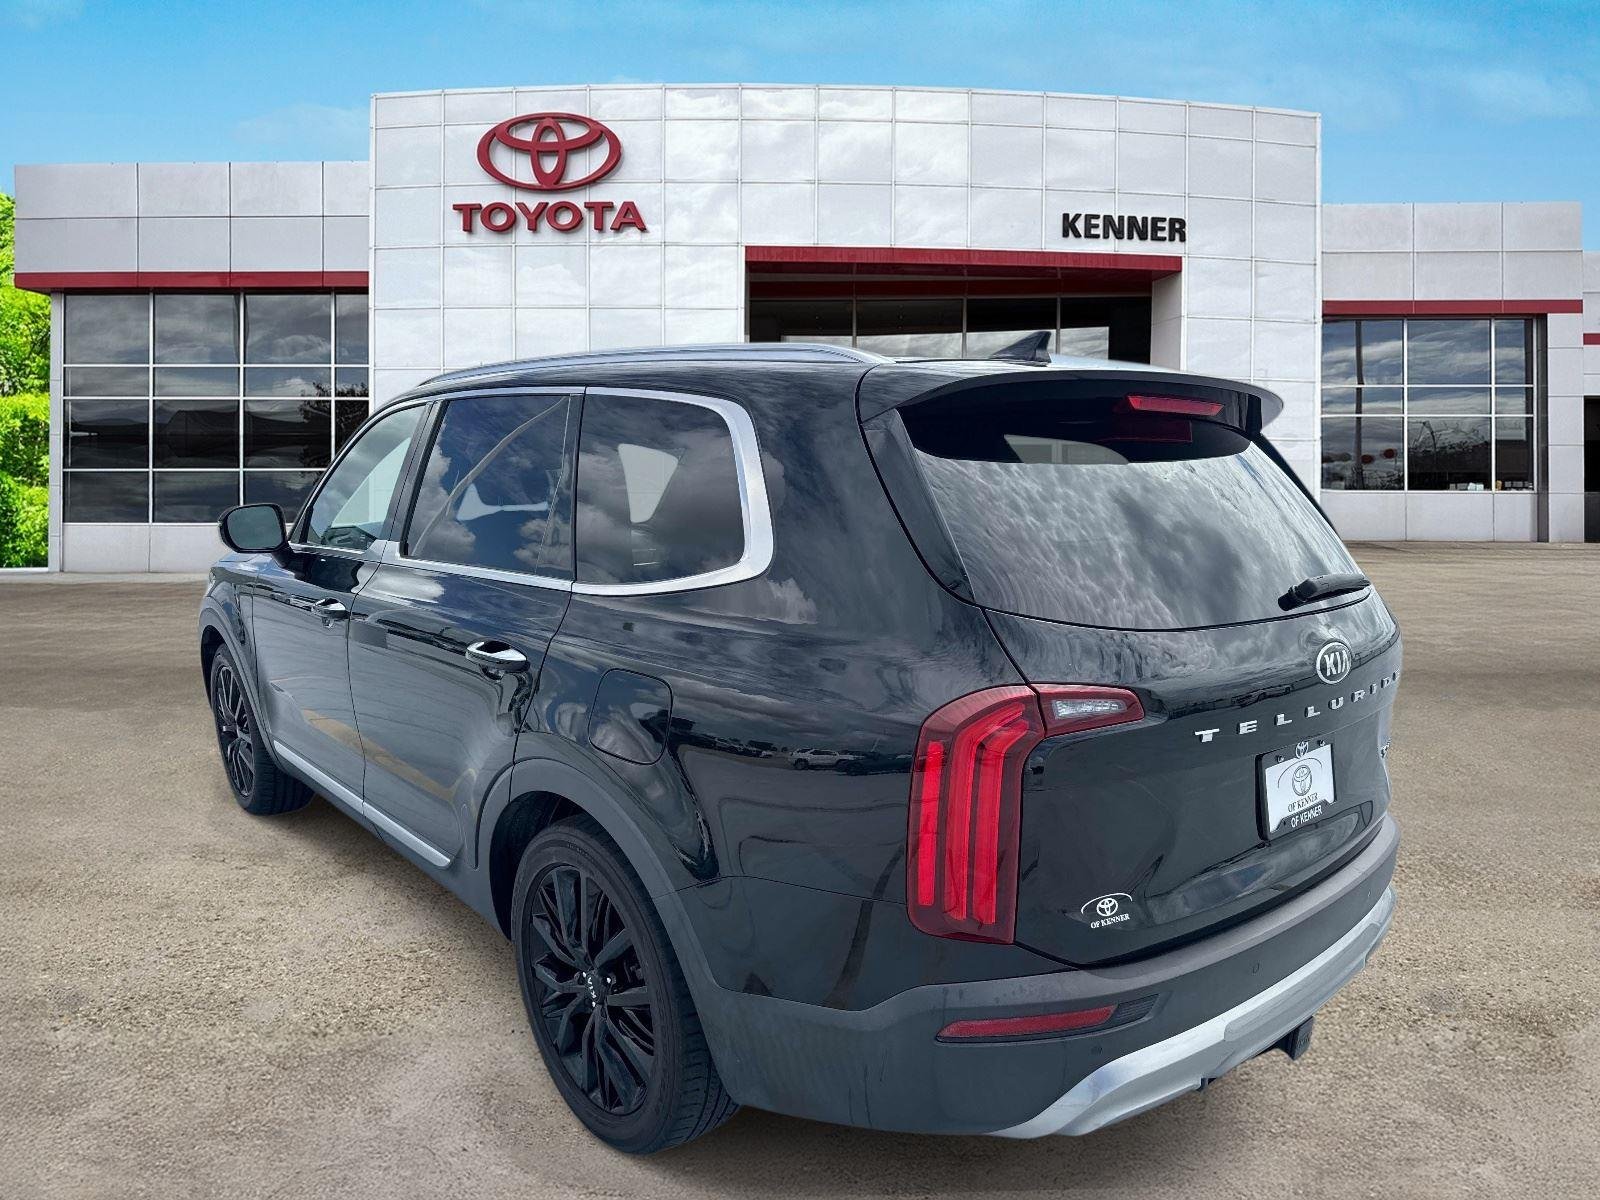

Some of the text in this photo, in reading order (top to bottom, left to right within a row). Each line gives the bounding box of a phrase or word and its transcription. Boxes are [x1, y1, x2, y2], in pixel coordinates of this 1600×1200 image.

[453, 200, 646, 232] TOYOTA
[1062, 213, 1187, 242] KENNER
[1323, 650, 1349, 677] KIA
[1288, 793, 1318, 813] OF KENNER
[1291, 805, 1322, 828] OF KENNER
[1101, 913, 1130, 926] KENNER
